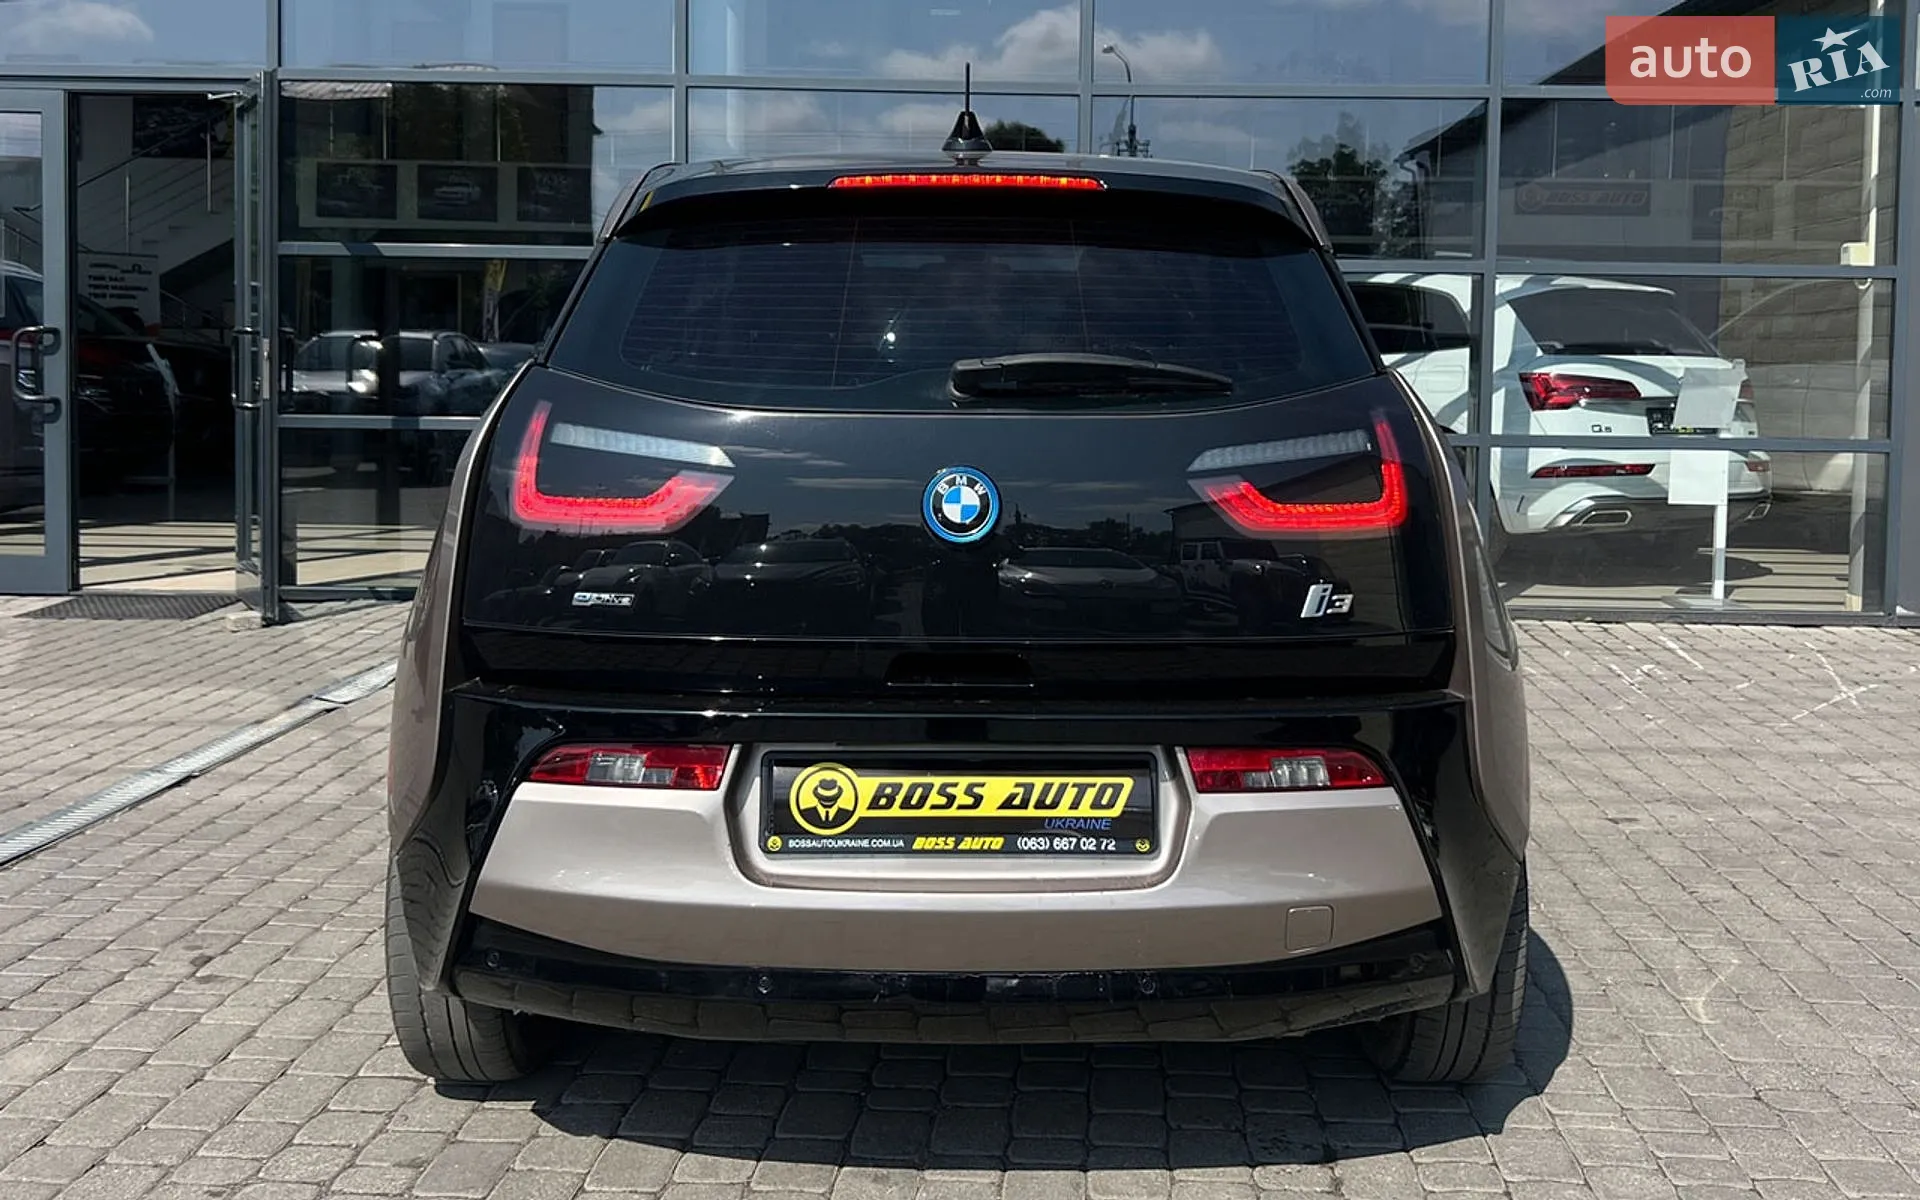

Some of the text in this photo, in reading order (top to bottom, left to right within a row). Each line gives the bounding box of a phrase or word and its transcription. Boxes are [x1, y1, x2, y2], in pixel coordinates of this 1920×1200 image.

[936, 473, 987, 495] BMW
[1300, 584, 1353, 618] i3
[866, 782, 1125, 810] BOSS AUTO
[1044, 818, 1113, 831] UKRAINE
[788, 838, 905, 849] BOSSAUTOUKRAINE.COM.UA
[912, 836, 1005, 850] BOSS AUTO
[1016, 837, 1116, 850] (063) 667 02 72
